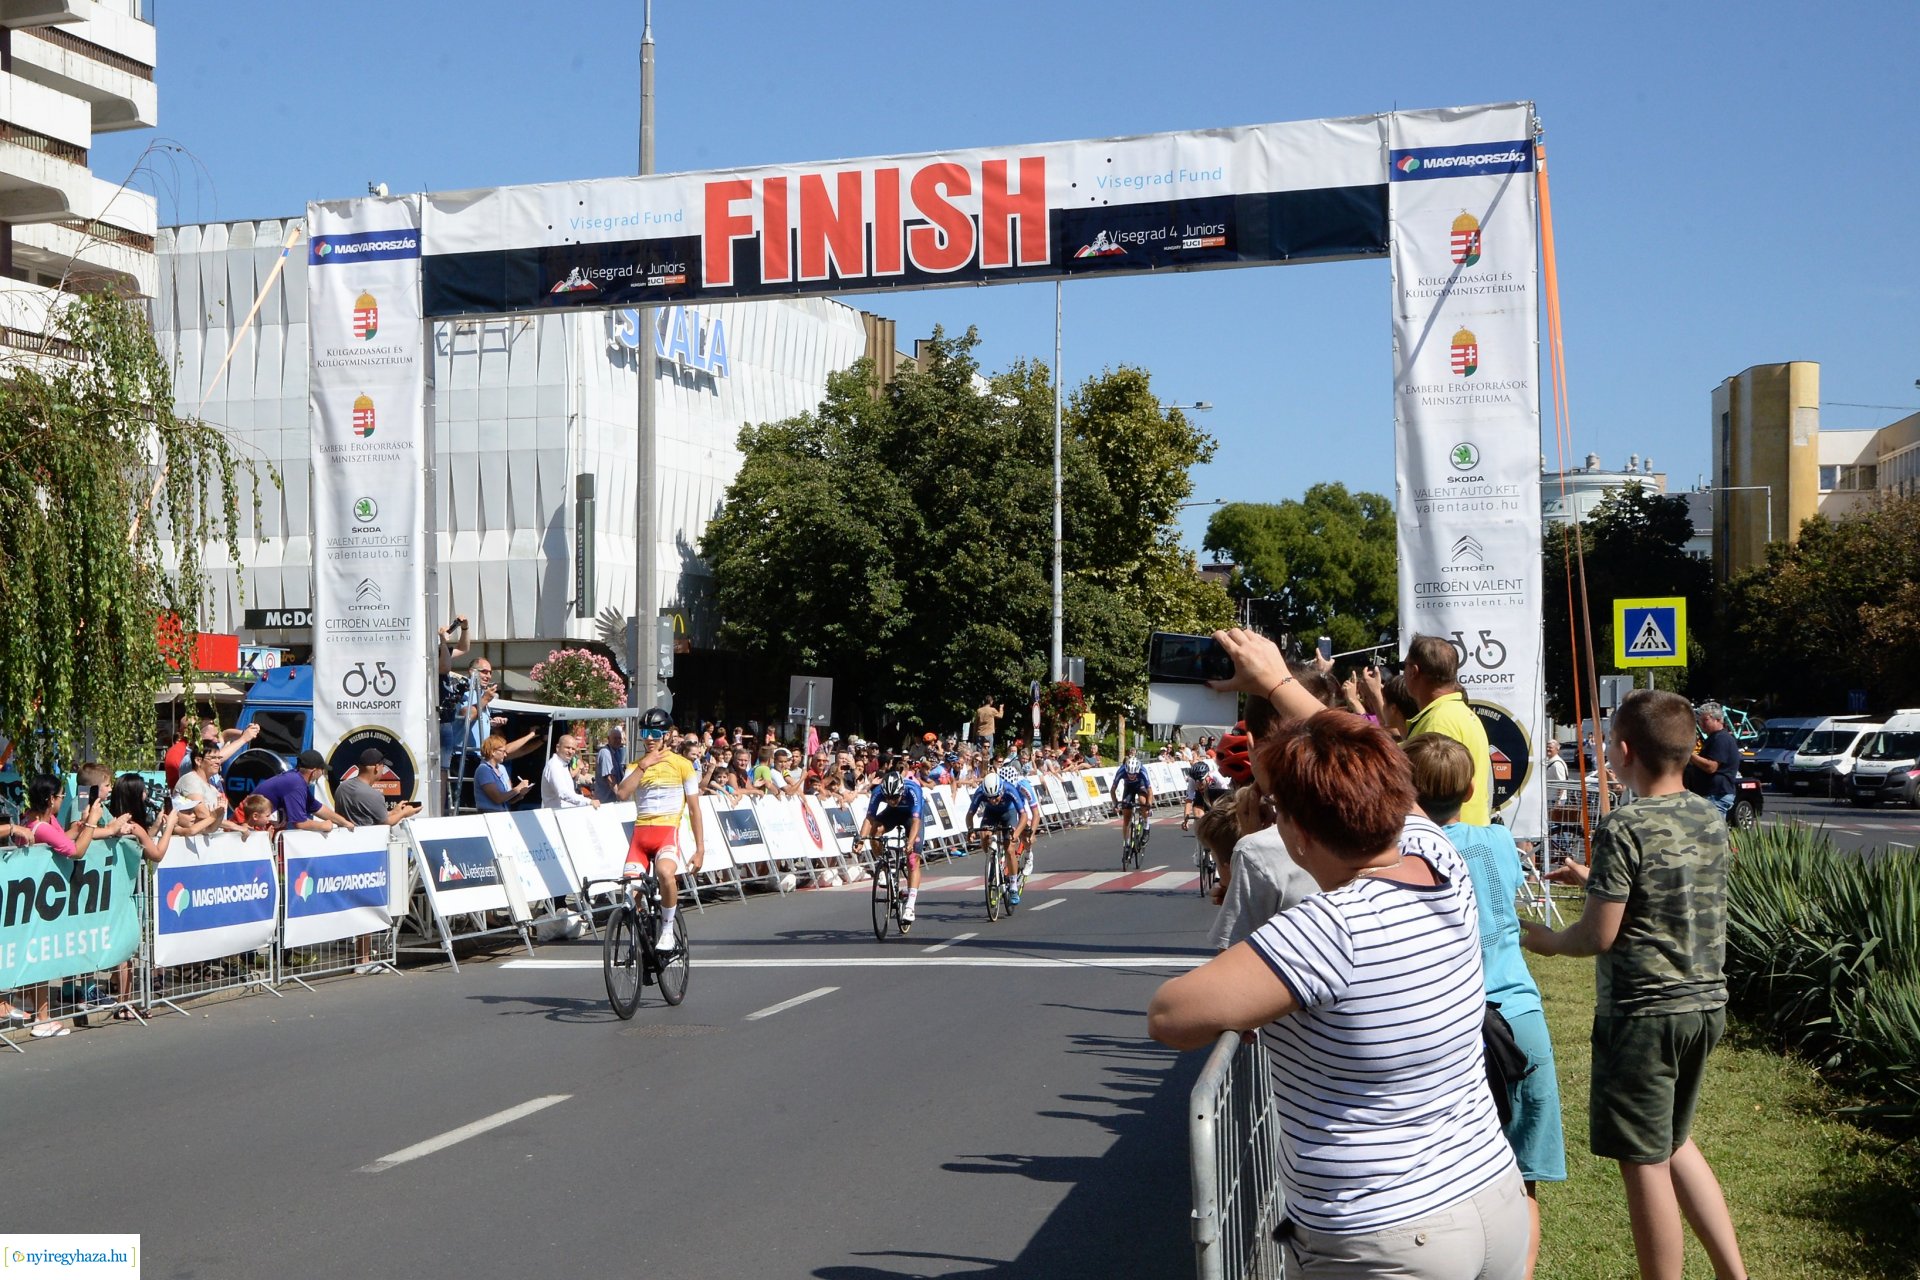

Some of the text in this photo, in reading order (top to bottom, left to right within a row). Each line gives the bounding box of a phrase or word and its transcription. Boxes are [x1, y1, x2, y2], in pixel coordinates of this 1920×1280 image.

[1423, 149, 1526, 169] MAGYARORSZÁG
[1096, 167, 1222, 190] Visegrad Fund
[570, 209, 683, 231] Visegrad Fund
[702, 155, 1050, 288] FINISH
[1109, 223, 1225, 245] Visegrad 4 Juniors
[334, 237, 416, 254] MAGYARORSZÁG
[581, 262, 686, 280] Visegrad 4 Juniors
[1501, 271, 1512, 280] ÉS
[1414, 487, 1457, 498] VALENT
[1460, 484, 1493, 496] AUTÓ
[1416, 500, 1518, 513] valentauto.hu
[327, 537, 359, 546] VALENT
[361, 535, 388, 545] AUTÓ
[327, 549, 408, 560] valentauto.hu
[1414, 579, 1523, 594] CITROËN VALENT
[1415, 598, 1524, 609] citroenvalent.hu
[325, 617, 411, 629] CITROËN VALENT
[326, 633, 411, 642] citroenvalent.hu
[1457, 673, 1515, 684] GASPORT
[336, 700, 402, 710] BRINGASPORT
[316, 866, 386, 893] MAGYARORSZÁG
[0, 856, 113, 927] nchi
[192, 877, 269, 907] MAGYARORSZÁG
[26, 926, 112, 963] CELESTE
